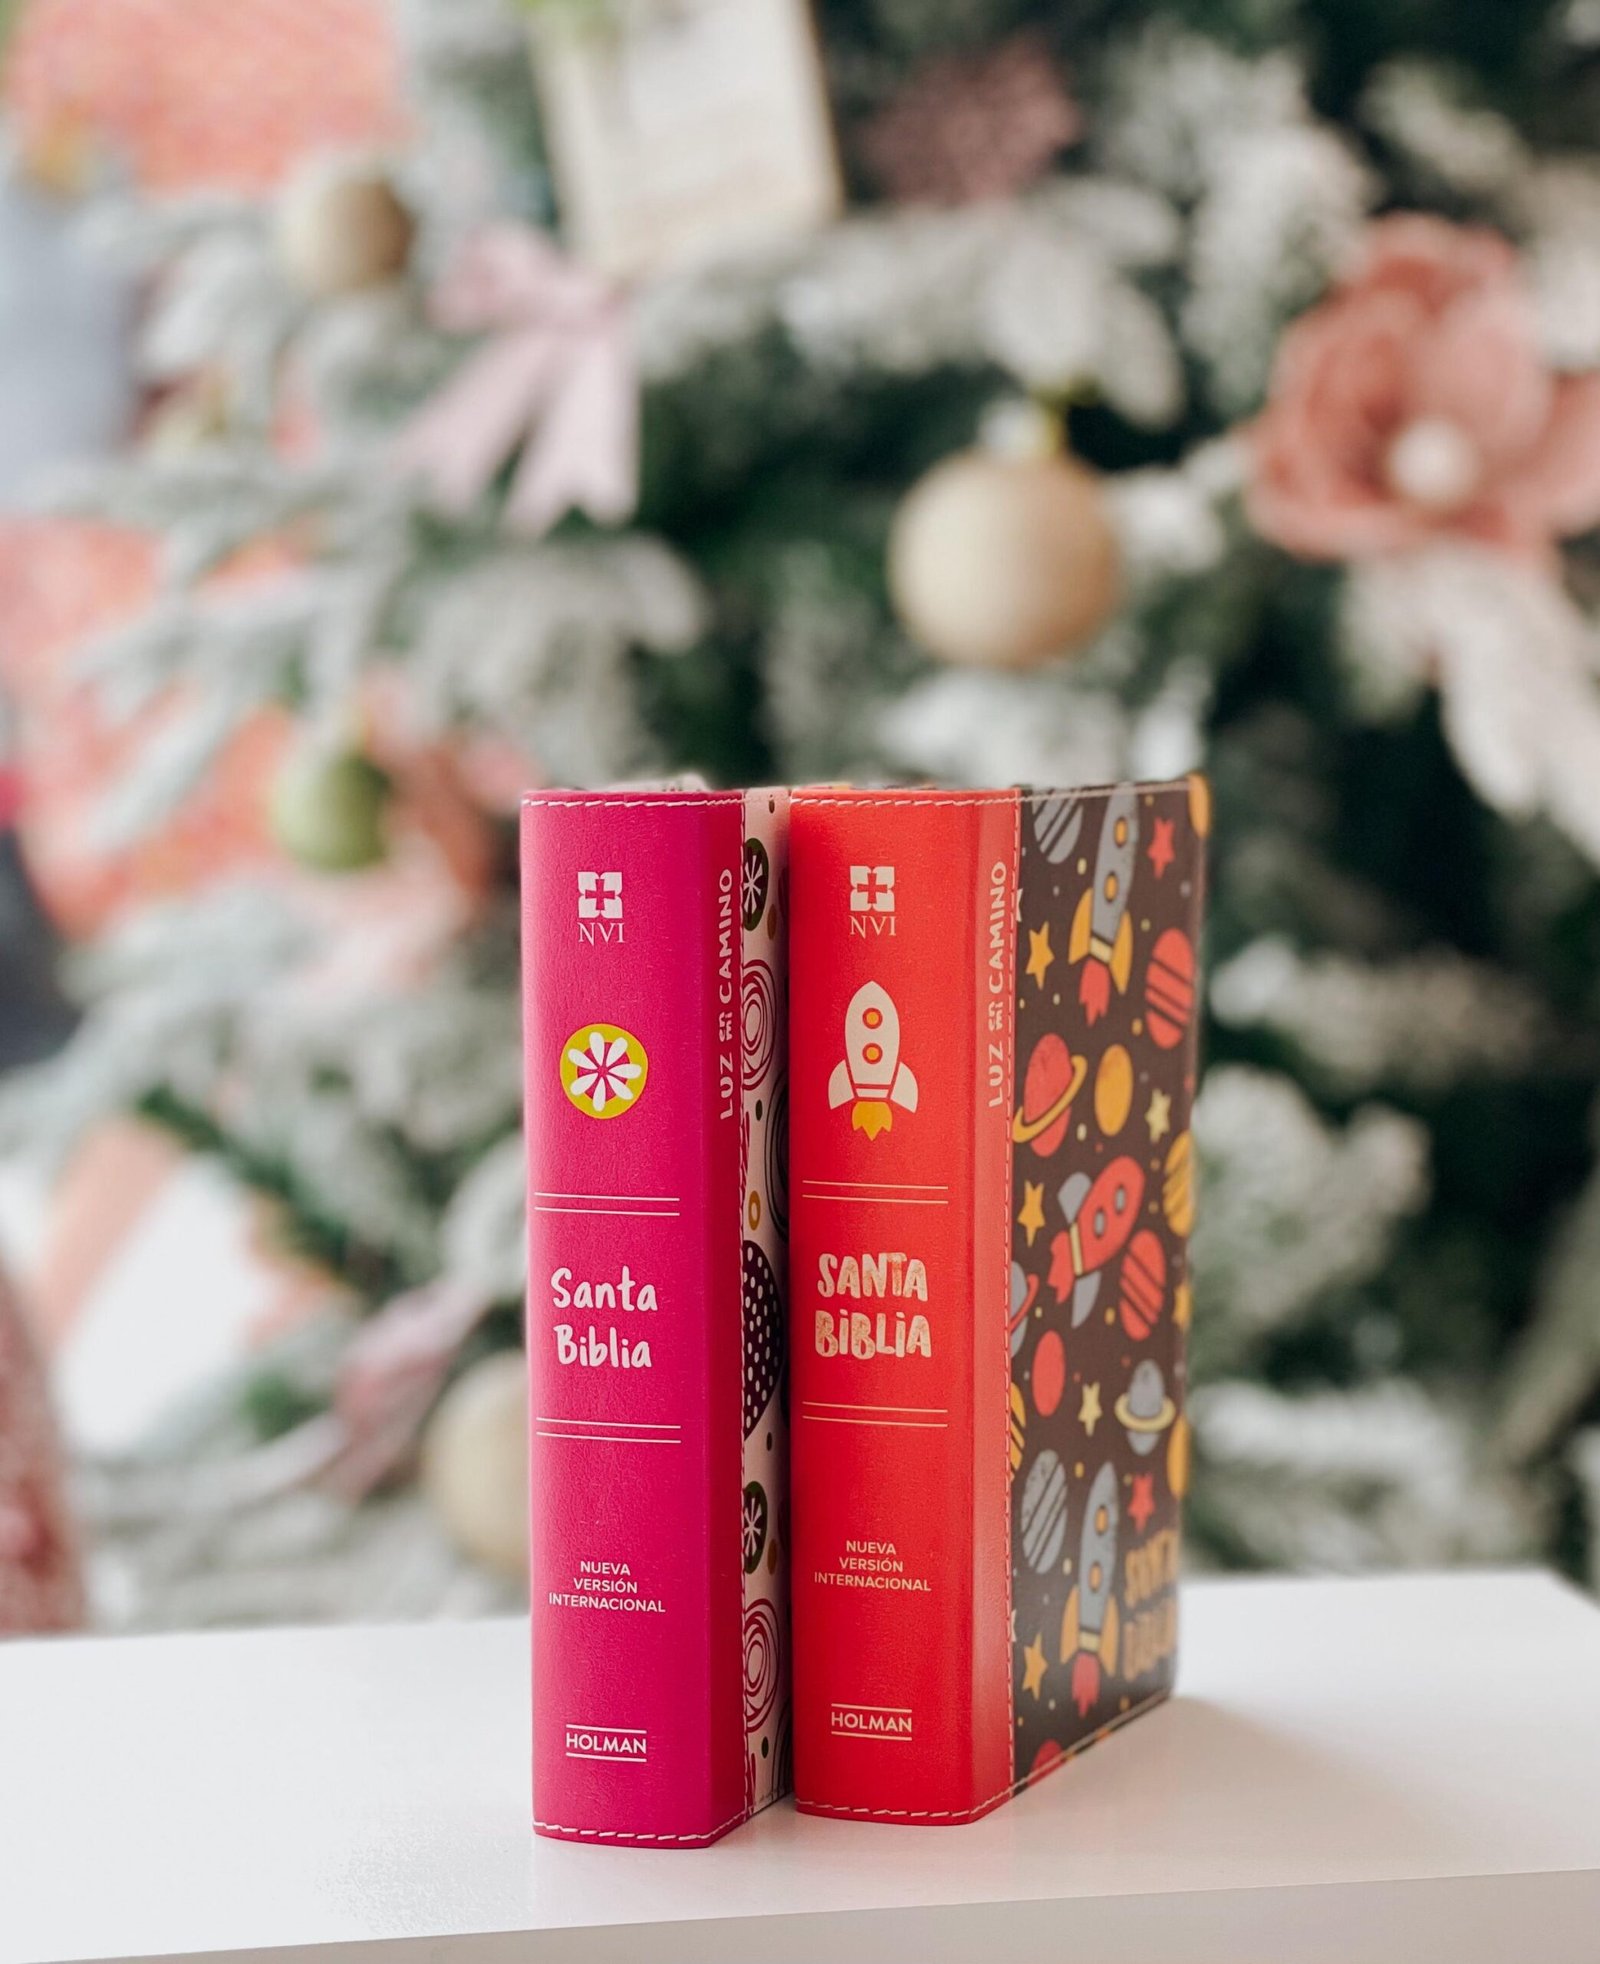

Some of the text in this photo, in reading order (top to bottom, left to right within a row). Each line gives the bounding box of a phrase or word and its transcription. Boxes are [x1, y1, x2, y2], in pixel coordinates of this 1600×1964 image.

[577, 921, 626, 945] NVI
[718, 868, 733, 1004] CAMINO
[850, 914, 897, 938] NVI
[988, 861, 1006, 995] CAMINO
[719, 1052, 734, 1120] LUZ
[988, 1041, 1003, 1108] LUZ
[550, 1265, 658, 1311] Santa
[817, 1252, 928, 1302] SANTA
[553, 1323, 652, 1369] Biblia
[845, 1540, 897, 1555] NUEVA
[580, 1560, 631, 1576] NUEVA
[839, 1555, 904, 1573] VERSIÓN
[573, 1577, 638, 1594] VERSIÓN
[814, 1571, 932, 1592] INTERNACIONAL
[549, 1592, 666, 1613] INTERNACIONAL
[831, 1711, 912, 1733] HOLMAN
[565, 1732, 647, 1754] HOLMAN
